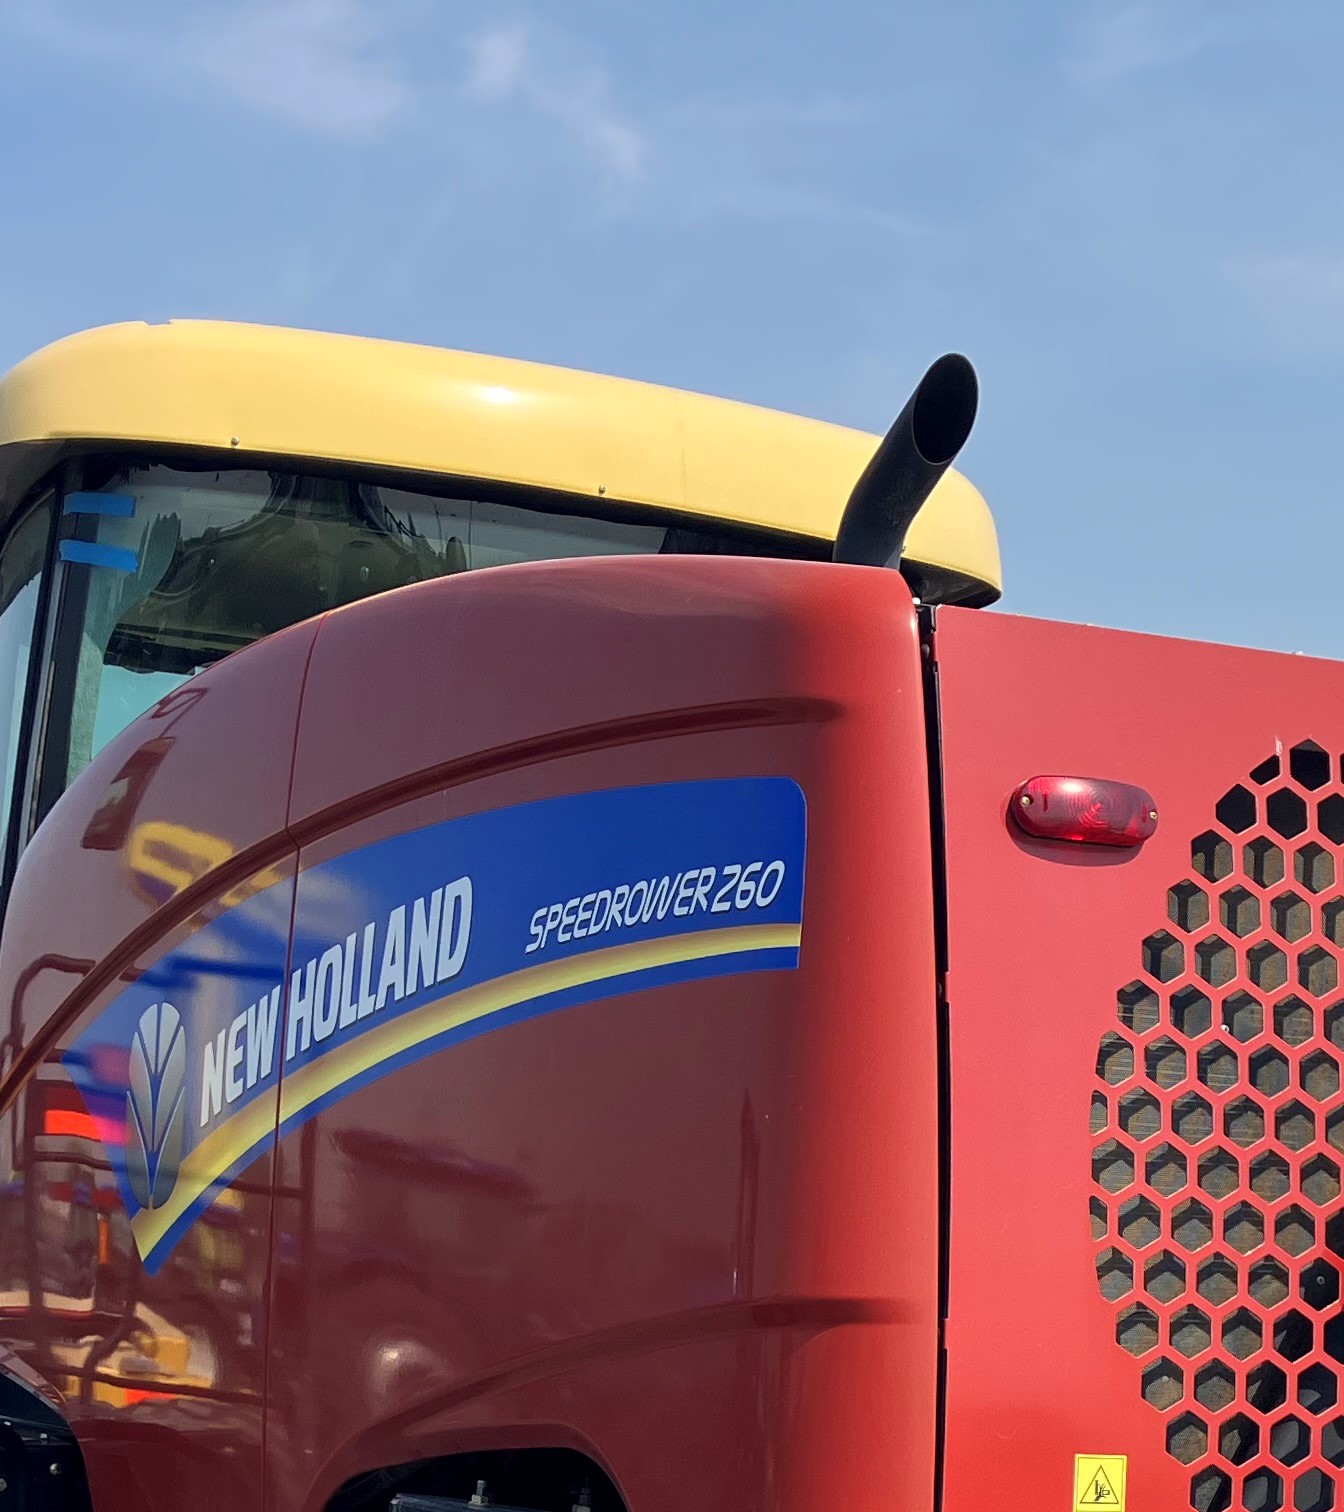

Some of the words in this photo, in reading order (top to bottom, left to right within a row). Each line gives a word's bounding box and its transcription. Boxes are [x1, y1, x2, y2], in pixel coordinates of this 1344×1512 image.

[525, 866, 716, 953] SPEEDROWER
[711, 860, 786, 914] 260
[200, 984, 281, 1128] NEW
[285, 876, 473, 1062] HOLLAND
